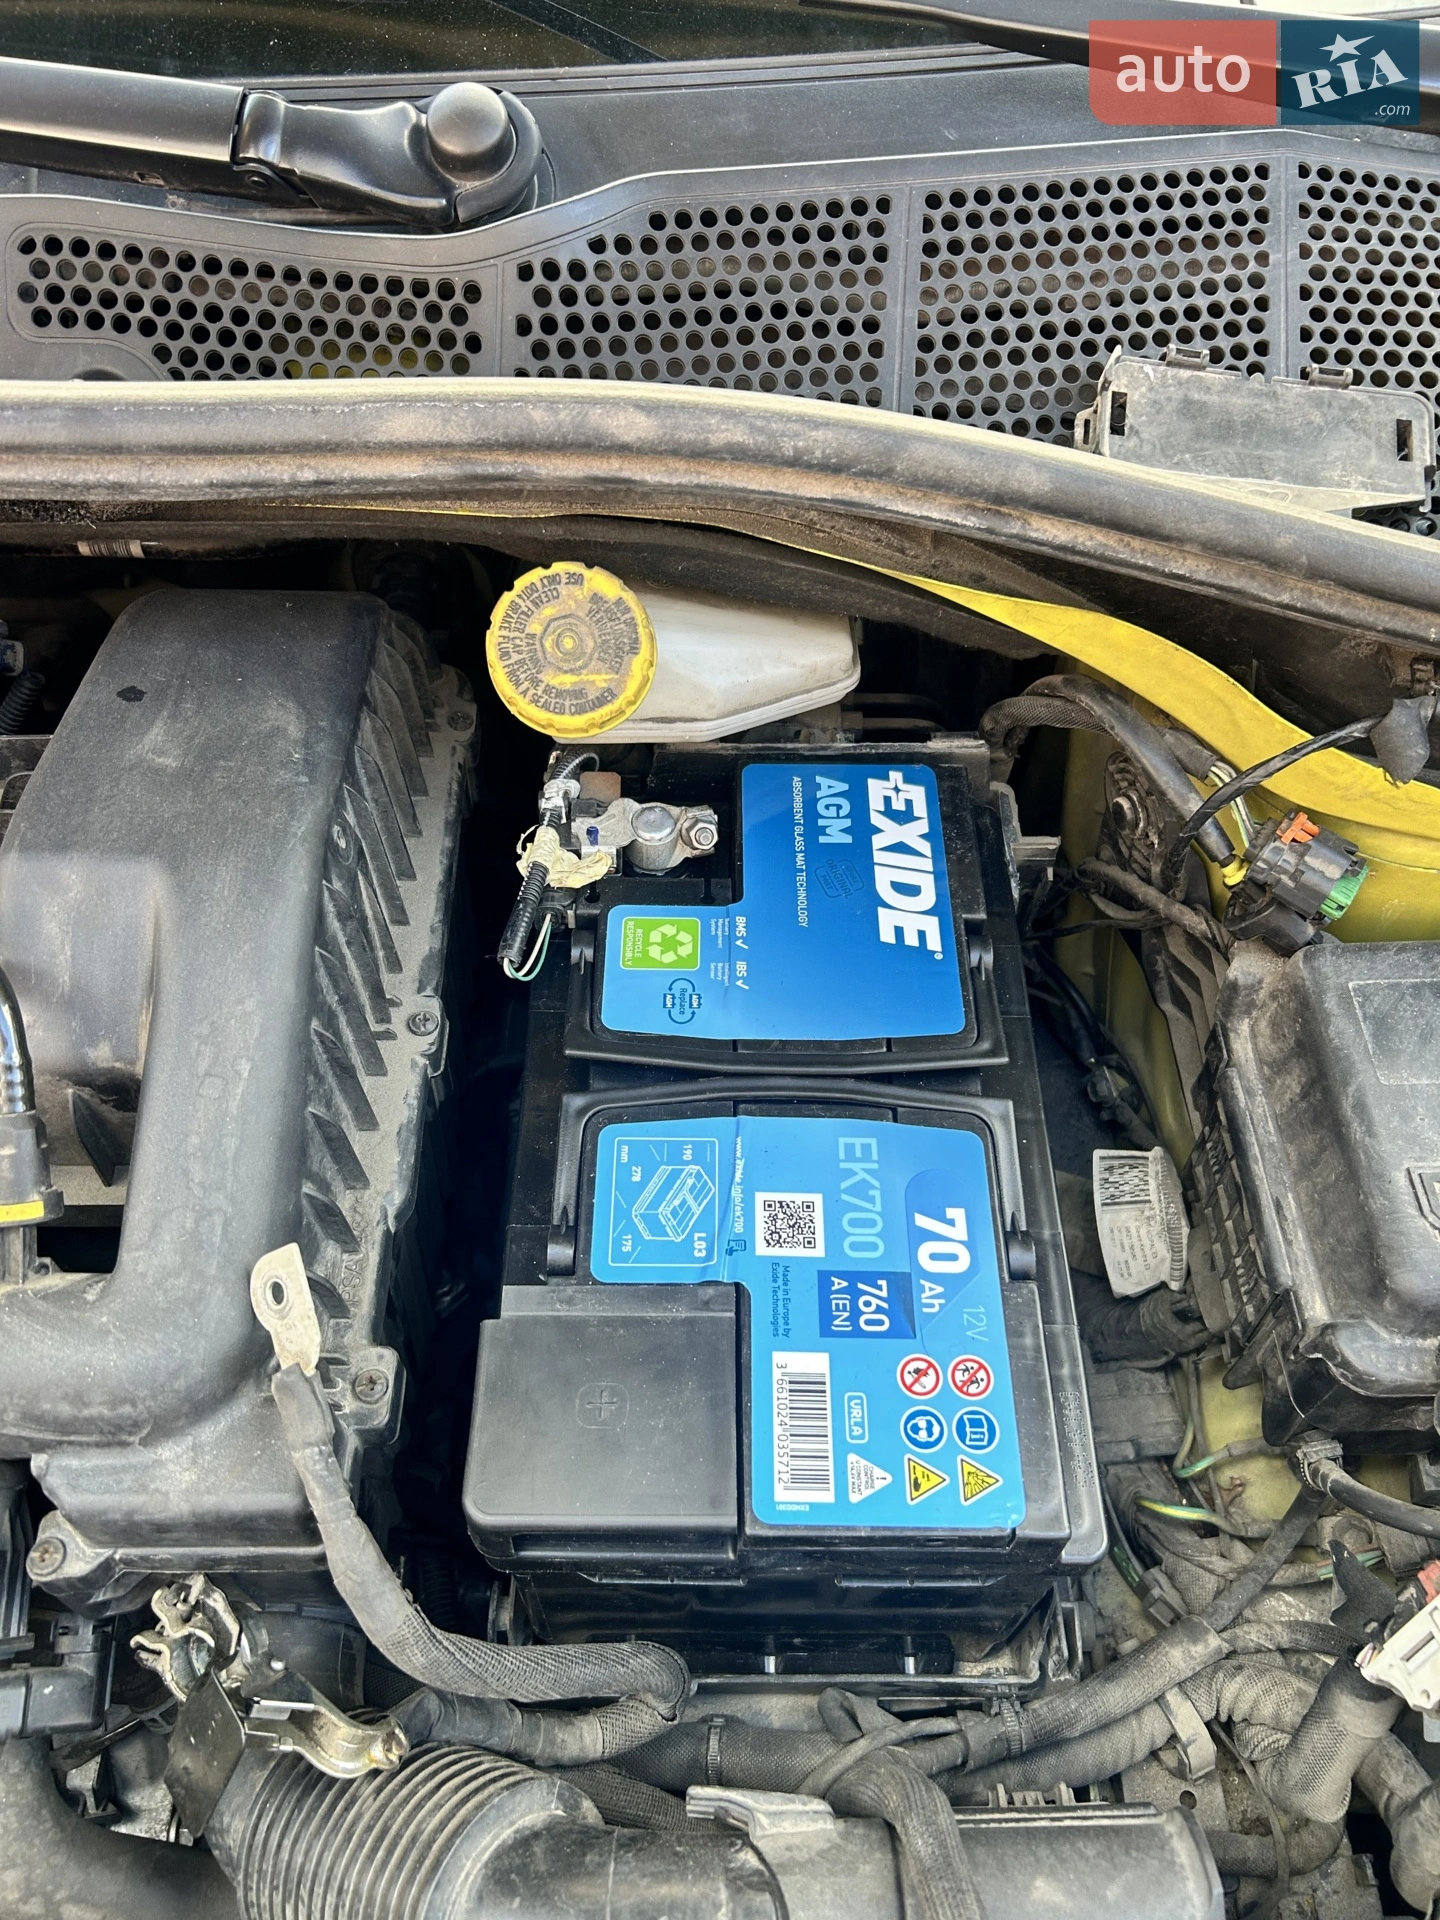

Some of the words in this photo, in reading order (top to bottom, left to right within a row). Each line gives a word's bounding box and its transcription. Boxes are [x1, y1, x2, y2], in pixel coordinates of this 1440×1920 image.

[516, 582, 539, 603] DOT4
[537, 574, 561, 590] ONLY
[564, 573, 584, 585] USE
[529, 587, 559, 609] CLEAN
[499, 600, 521, 633] BRAKE
[513, 605, 534, 634] FILLER
[498, 635, 511, 662] FLUID
[512, 636, 523, 656] CAP
[525, 631, 546, 675] WARNING
[502, 662, 524, 690] FROM
[515, 657, 542, 690] BEFORE
[519, 685, 531, 697] A
[528, 692, 565, 713] SEALED
[569, 686, 617, 713] CONTAINER
[793, 776, 805, 824] ABSORBENT
[815, 775, 853, 844] AGM
[794, 825, 806, 851] GLASS
[795, 853, 806, 870] MAT
[867, 771, 943, 952] EXIDE
[820, 874, 833, 890] PART
[825, 859, 853, 899] ORIGINAL
[795, 872, 808, 928] TECHNOLOGY
[736, 916, 746, 937] BMS
[624, 921, 635, 966] RESPONSIBLY
[634, 928, 644, 958] RECYCLE
[736, 961, 747, 977] IBS
[678, 988, 687, 1015] Replace
[620, 1145, 628, 1163] mm
[683, 1144, 692, 1160] 190
[632, 1166, 641, 1182] 278
[734, 1136, 744, 1233] www.exide.info/ek700
[837, 1137, 885, 1259] EK700
[622, 1234, 632, 1252] 175
[913, 1206, 972, 1274] 70
[770, 1262, 781, 1283] Exide
[781, 1265, 791, 1287] Made
[831, 1276, 849, 1290] A
[781, 1288, 791, 1296] in
[857, 1280, 890, 1331] 760
[919, 1279, 944, 1313] Ah
[770, 1284, 782, 1338] Technologies
[779, 1298, 792, 1325] Europe
[830, 1294, 853, 1331] (EN)
[961, 1304, 988, 1342] 12V
[781, 1327, 793, 1338] by
[776, 1377, 790, 1427] 661024
[849, 1399, 862, 1436] VRLA
[776, 1433, 790, 1485] 035712
